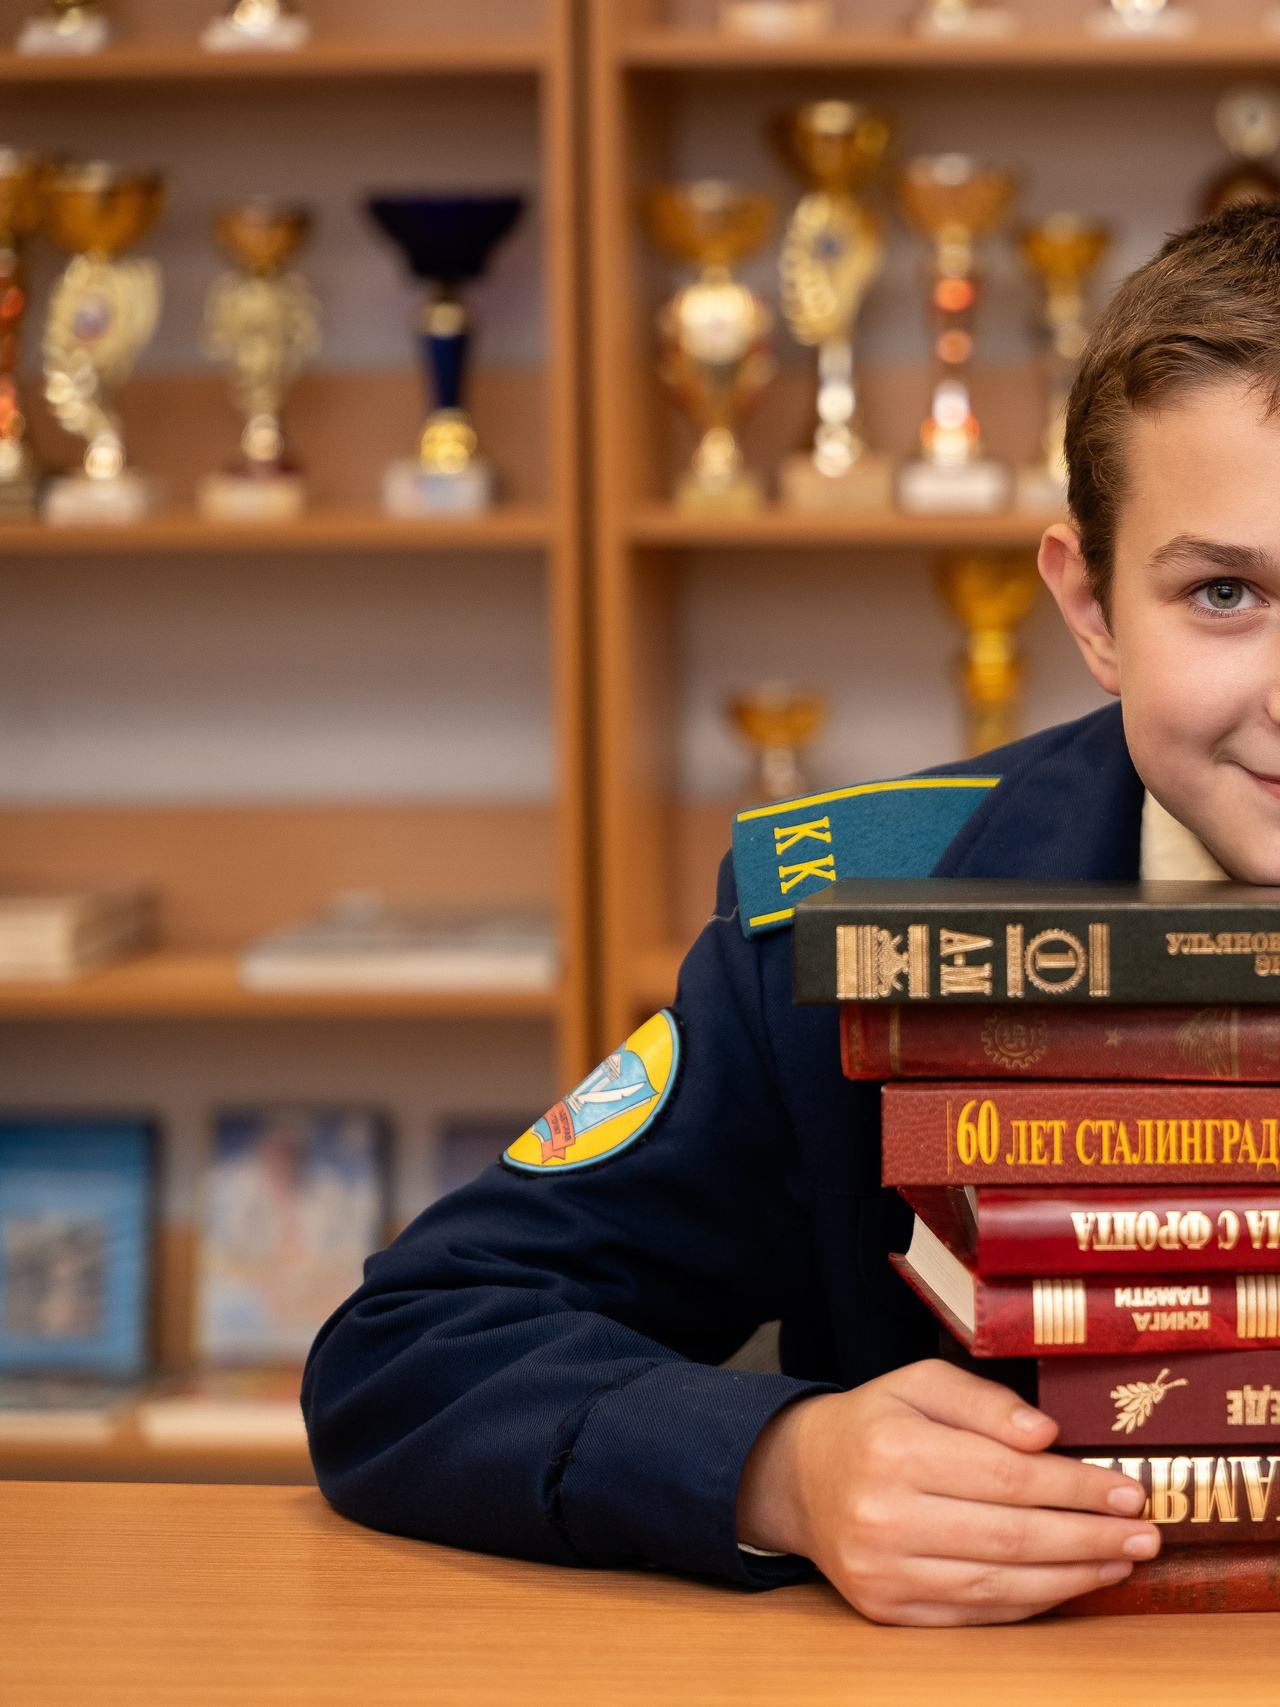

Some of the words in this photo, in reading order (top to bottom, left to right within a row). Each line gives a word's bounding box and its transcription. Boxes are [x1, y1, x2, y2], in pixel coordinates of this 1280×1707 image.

[956, 1099, 999, 1165] 60
[1005, 1118, 1066, 1165] ЛЕТ
[1070, 1210, 1213, 1251] ФРОНТА
[1217, 1210, 1239, 1250] С
[1114, 1286, 1211, 1308] ПАМЯТИ
[1132, 1311, 1210, 1331] КНИГА
